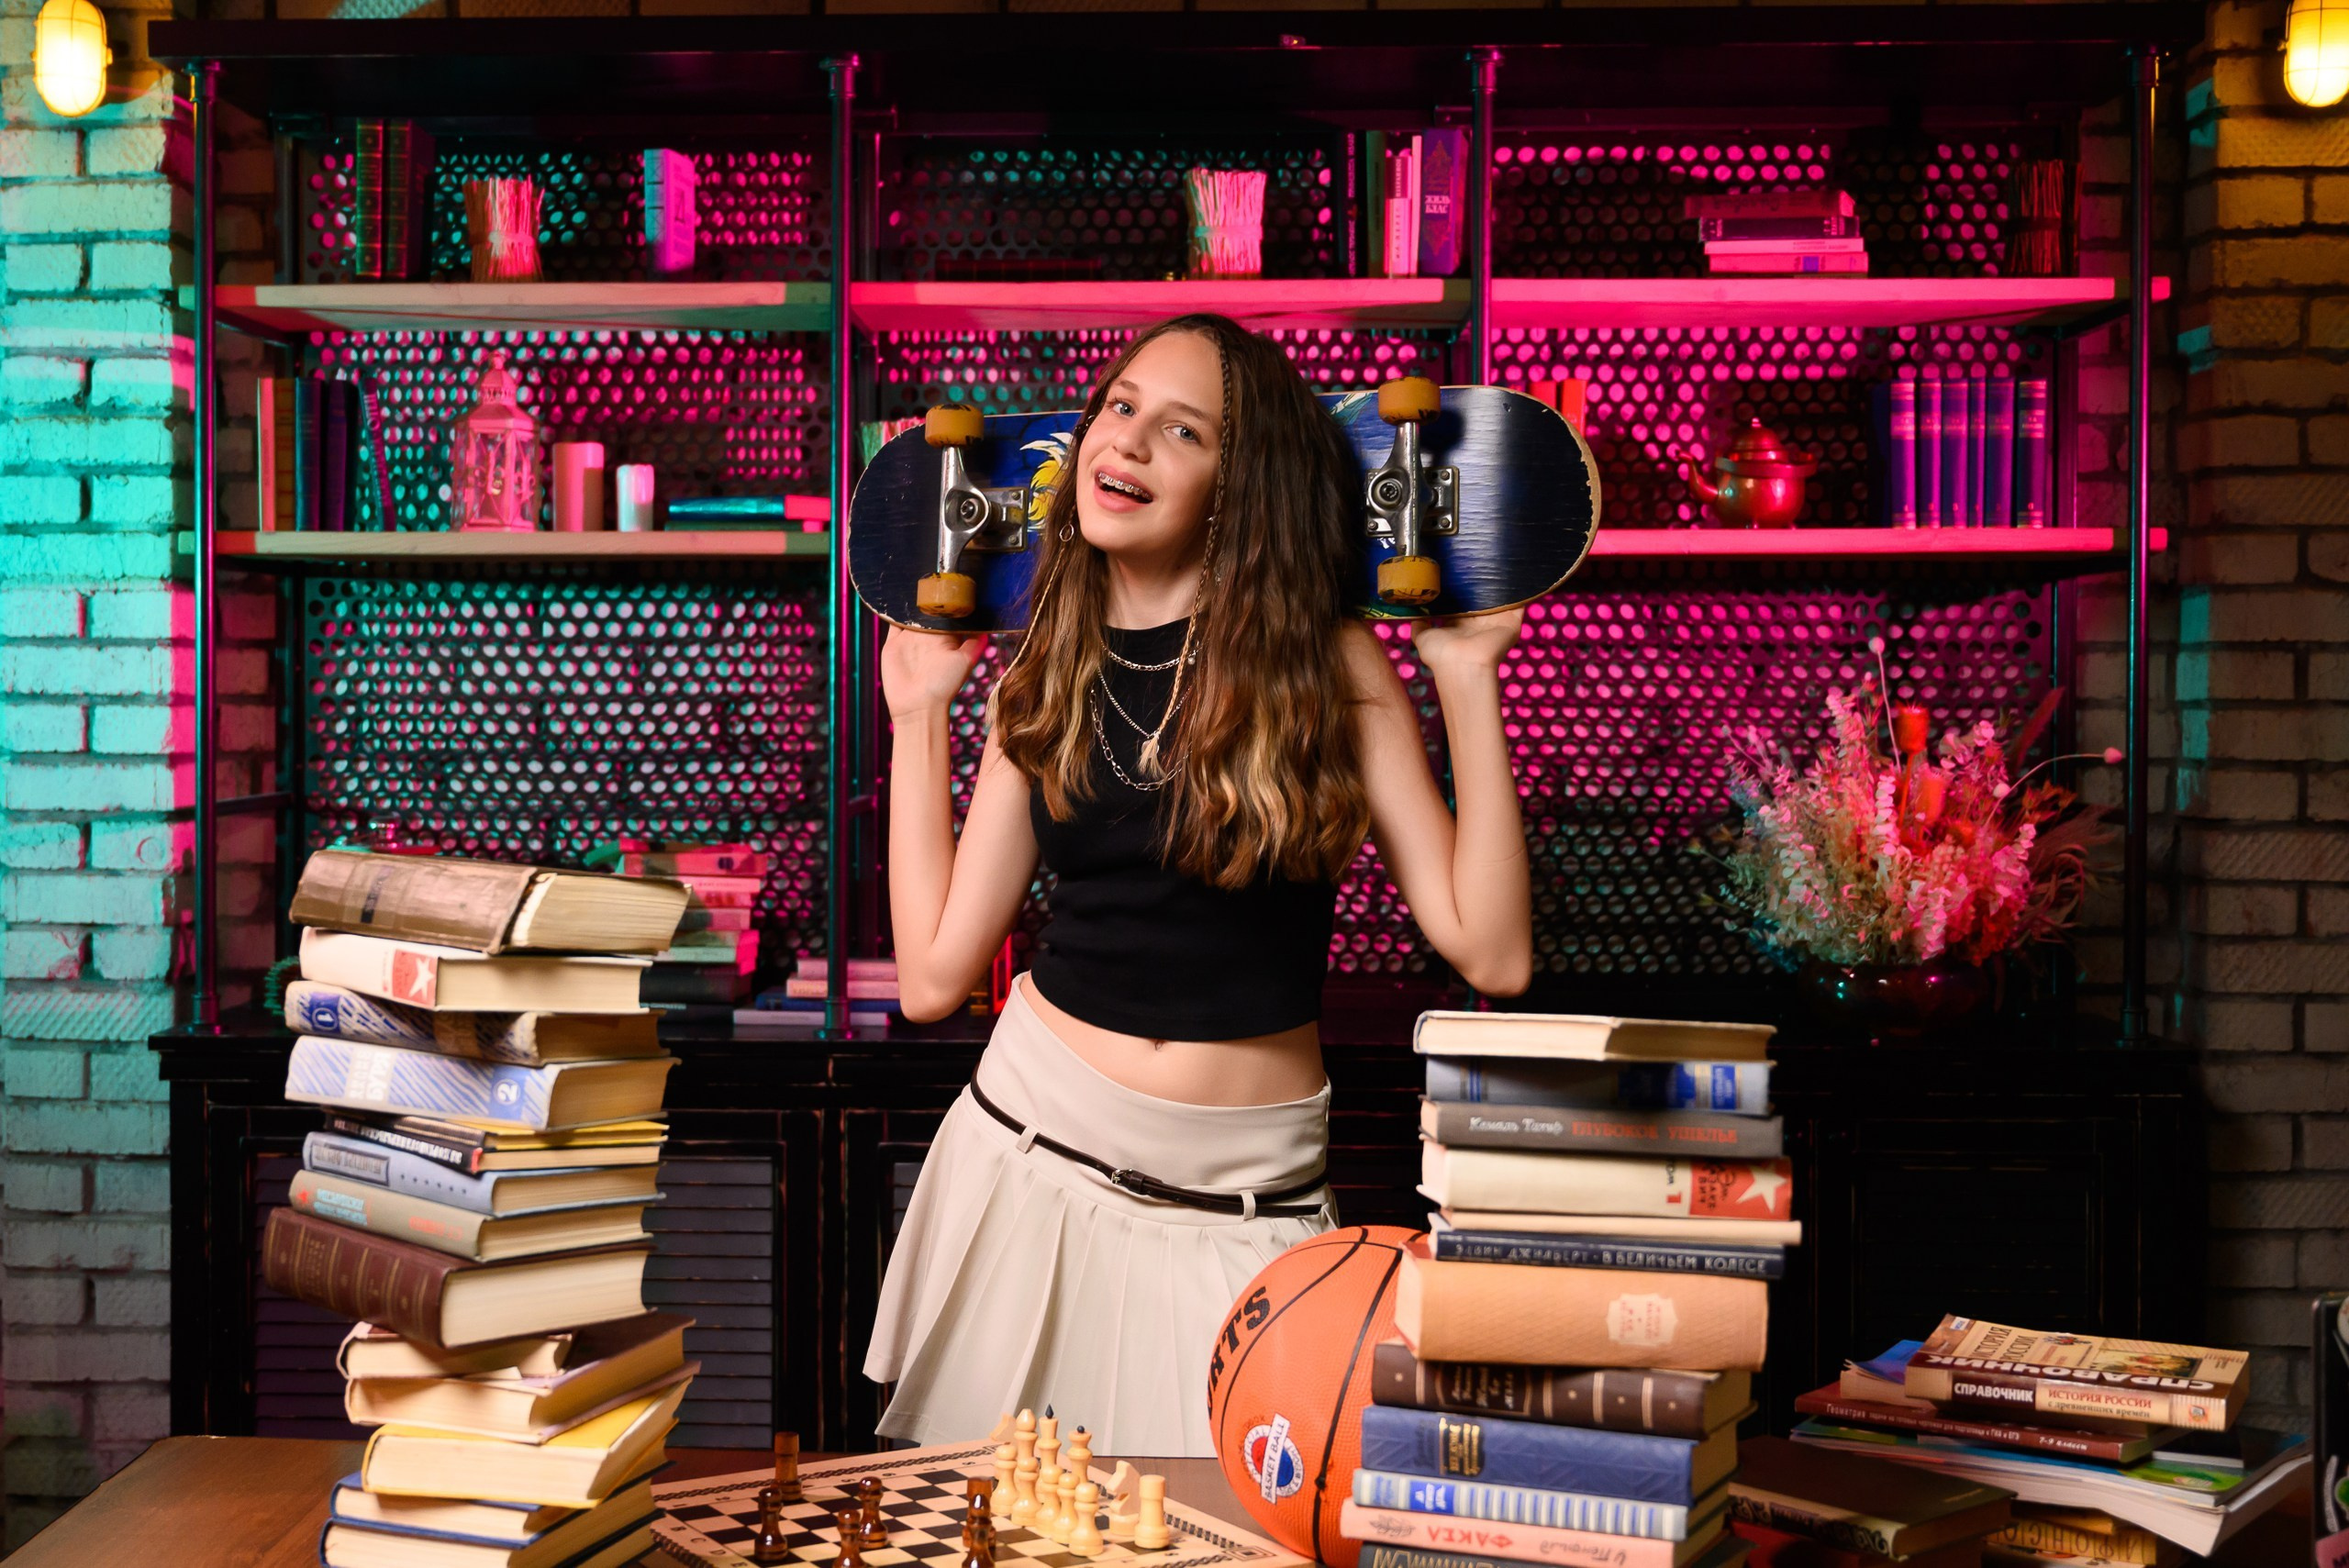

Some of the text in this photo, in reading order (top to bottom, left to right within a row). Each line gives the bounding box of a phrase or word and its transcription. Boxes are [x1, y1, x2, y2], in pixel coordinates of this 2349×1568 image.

[496, 1083, 519, 1103] 2
[1602, 1251, 1612, 1264] В
[1616, 1251, 1698, 1270] БЕЛИЧЬЕМ
[1705, 1254, 1767, 1273] КОЛЕСЕ
[1924, 1354, 2214, 1391] СПРАВОЧНИК
[1954, 1383, 2034, 1404] СПРАВОЧНИК
[2048, 1389, 2152, 1410] ИСТОРИЯ РОССИИ
[1826, 1403, 1866, 1419] Геометрия
[1264, 1422, 1286, 1499] BASKET BALL
